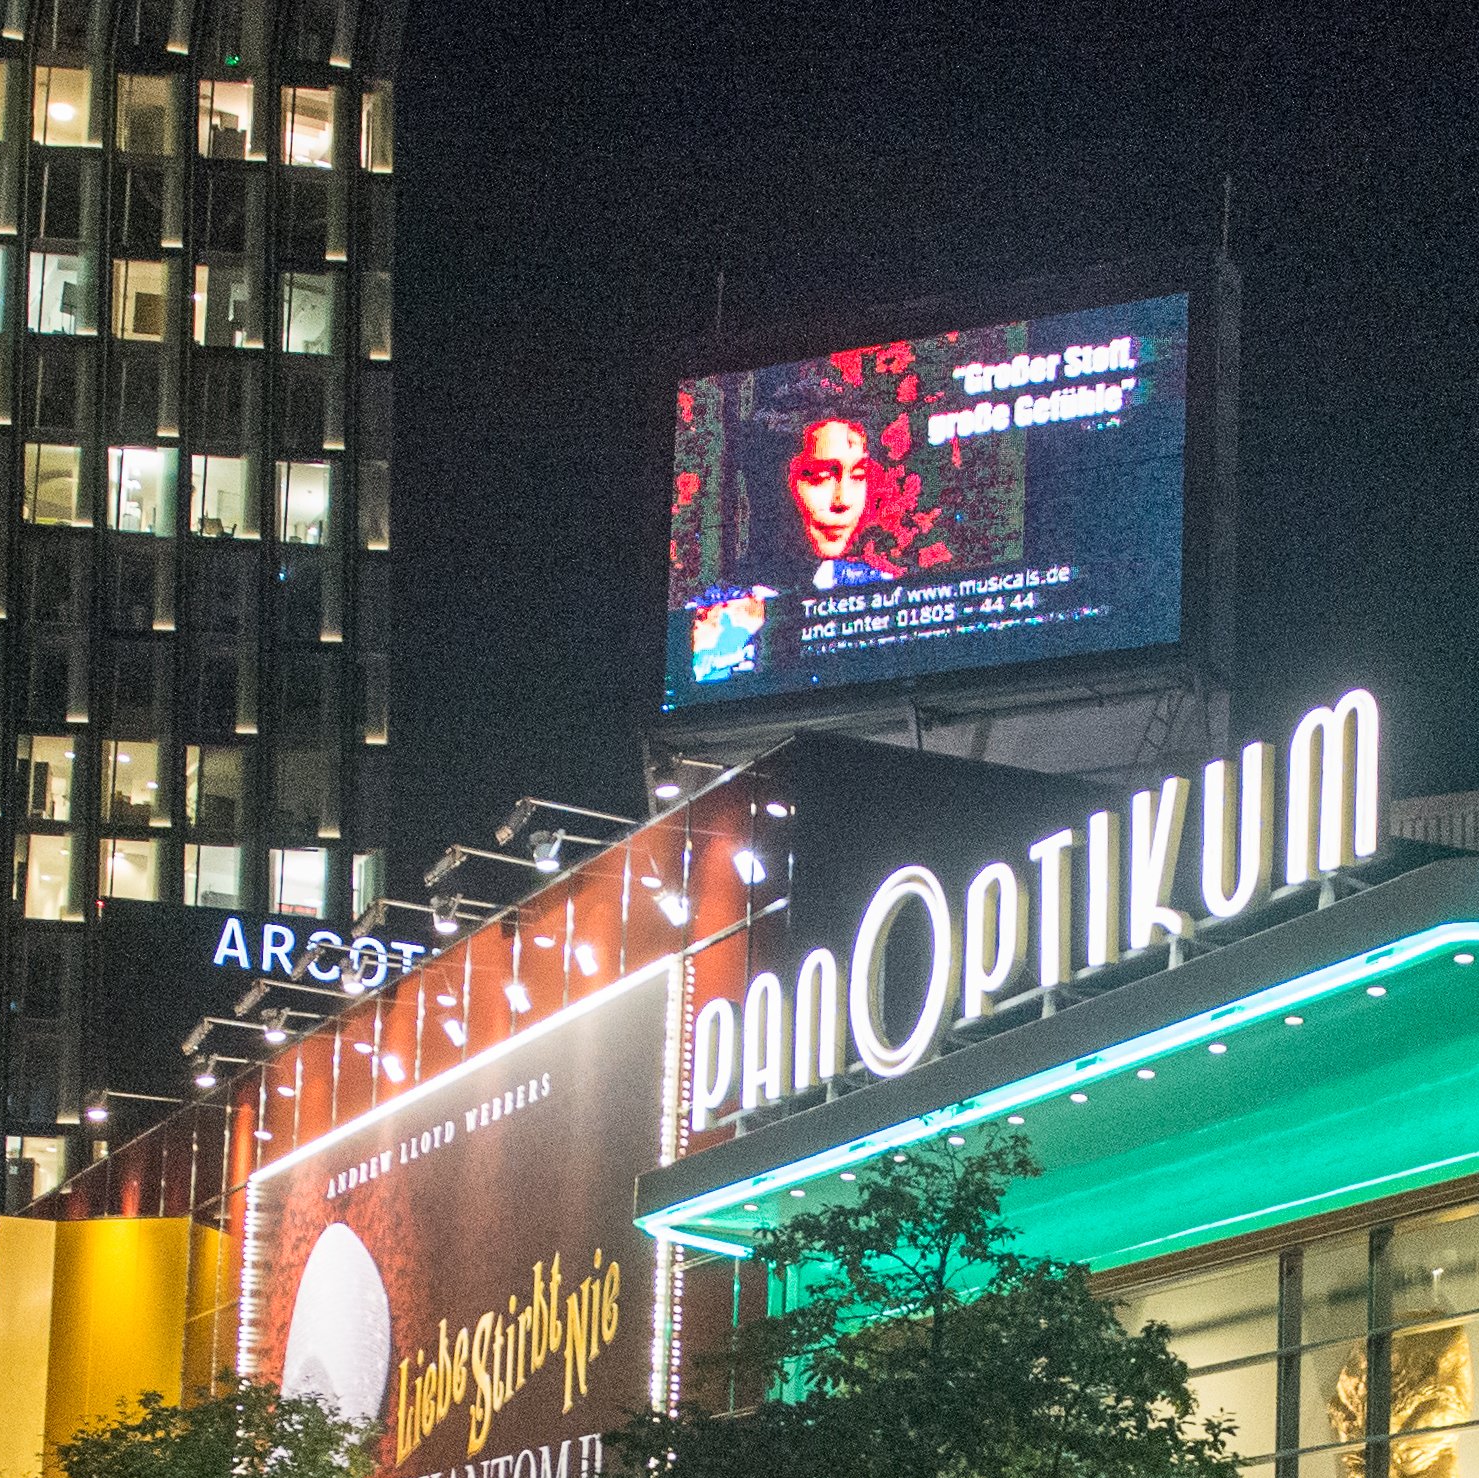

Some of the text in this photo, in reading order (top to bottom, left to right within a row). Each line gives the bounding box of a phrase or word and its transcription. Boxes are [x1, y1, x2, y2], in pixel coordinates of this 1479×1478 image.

[801, 564, 1070, 617] Tickets auf www.musicals.de
[801, 620, 836, 641] und
[841, 614, 890, 635] unter
[896, 602, 956, 627] 01805
[980, 597, 1005, 613] 44
[1009, 591, 1035, 611] 44
[213, 916, 441, 989] ARCOT
[690, 688, 1382, 1133] PANOPTIKUM
[326, 1072, 551, 1199] ANDREW LLOYD WEBBERS
[395, 1247, 620, 1468] Liebe Stirbt Nie
